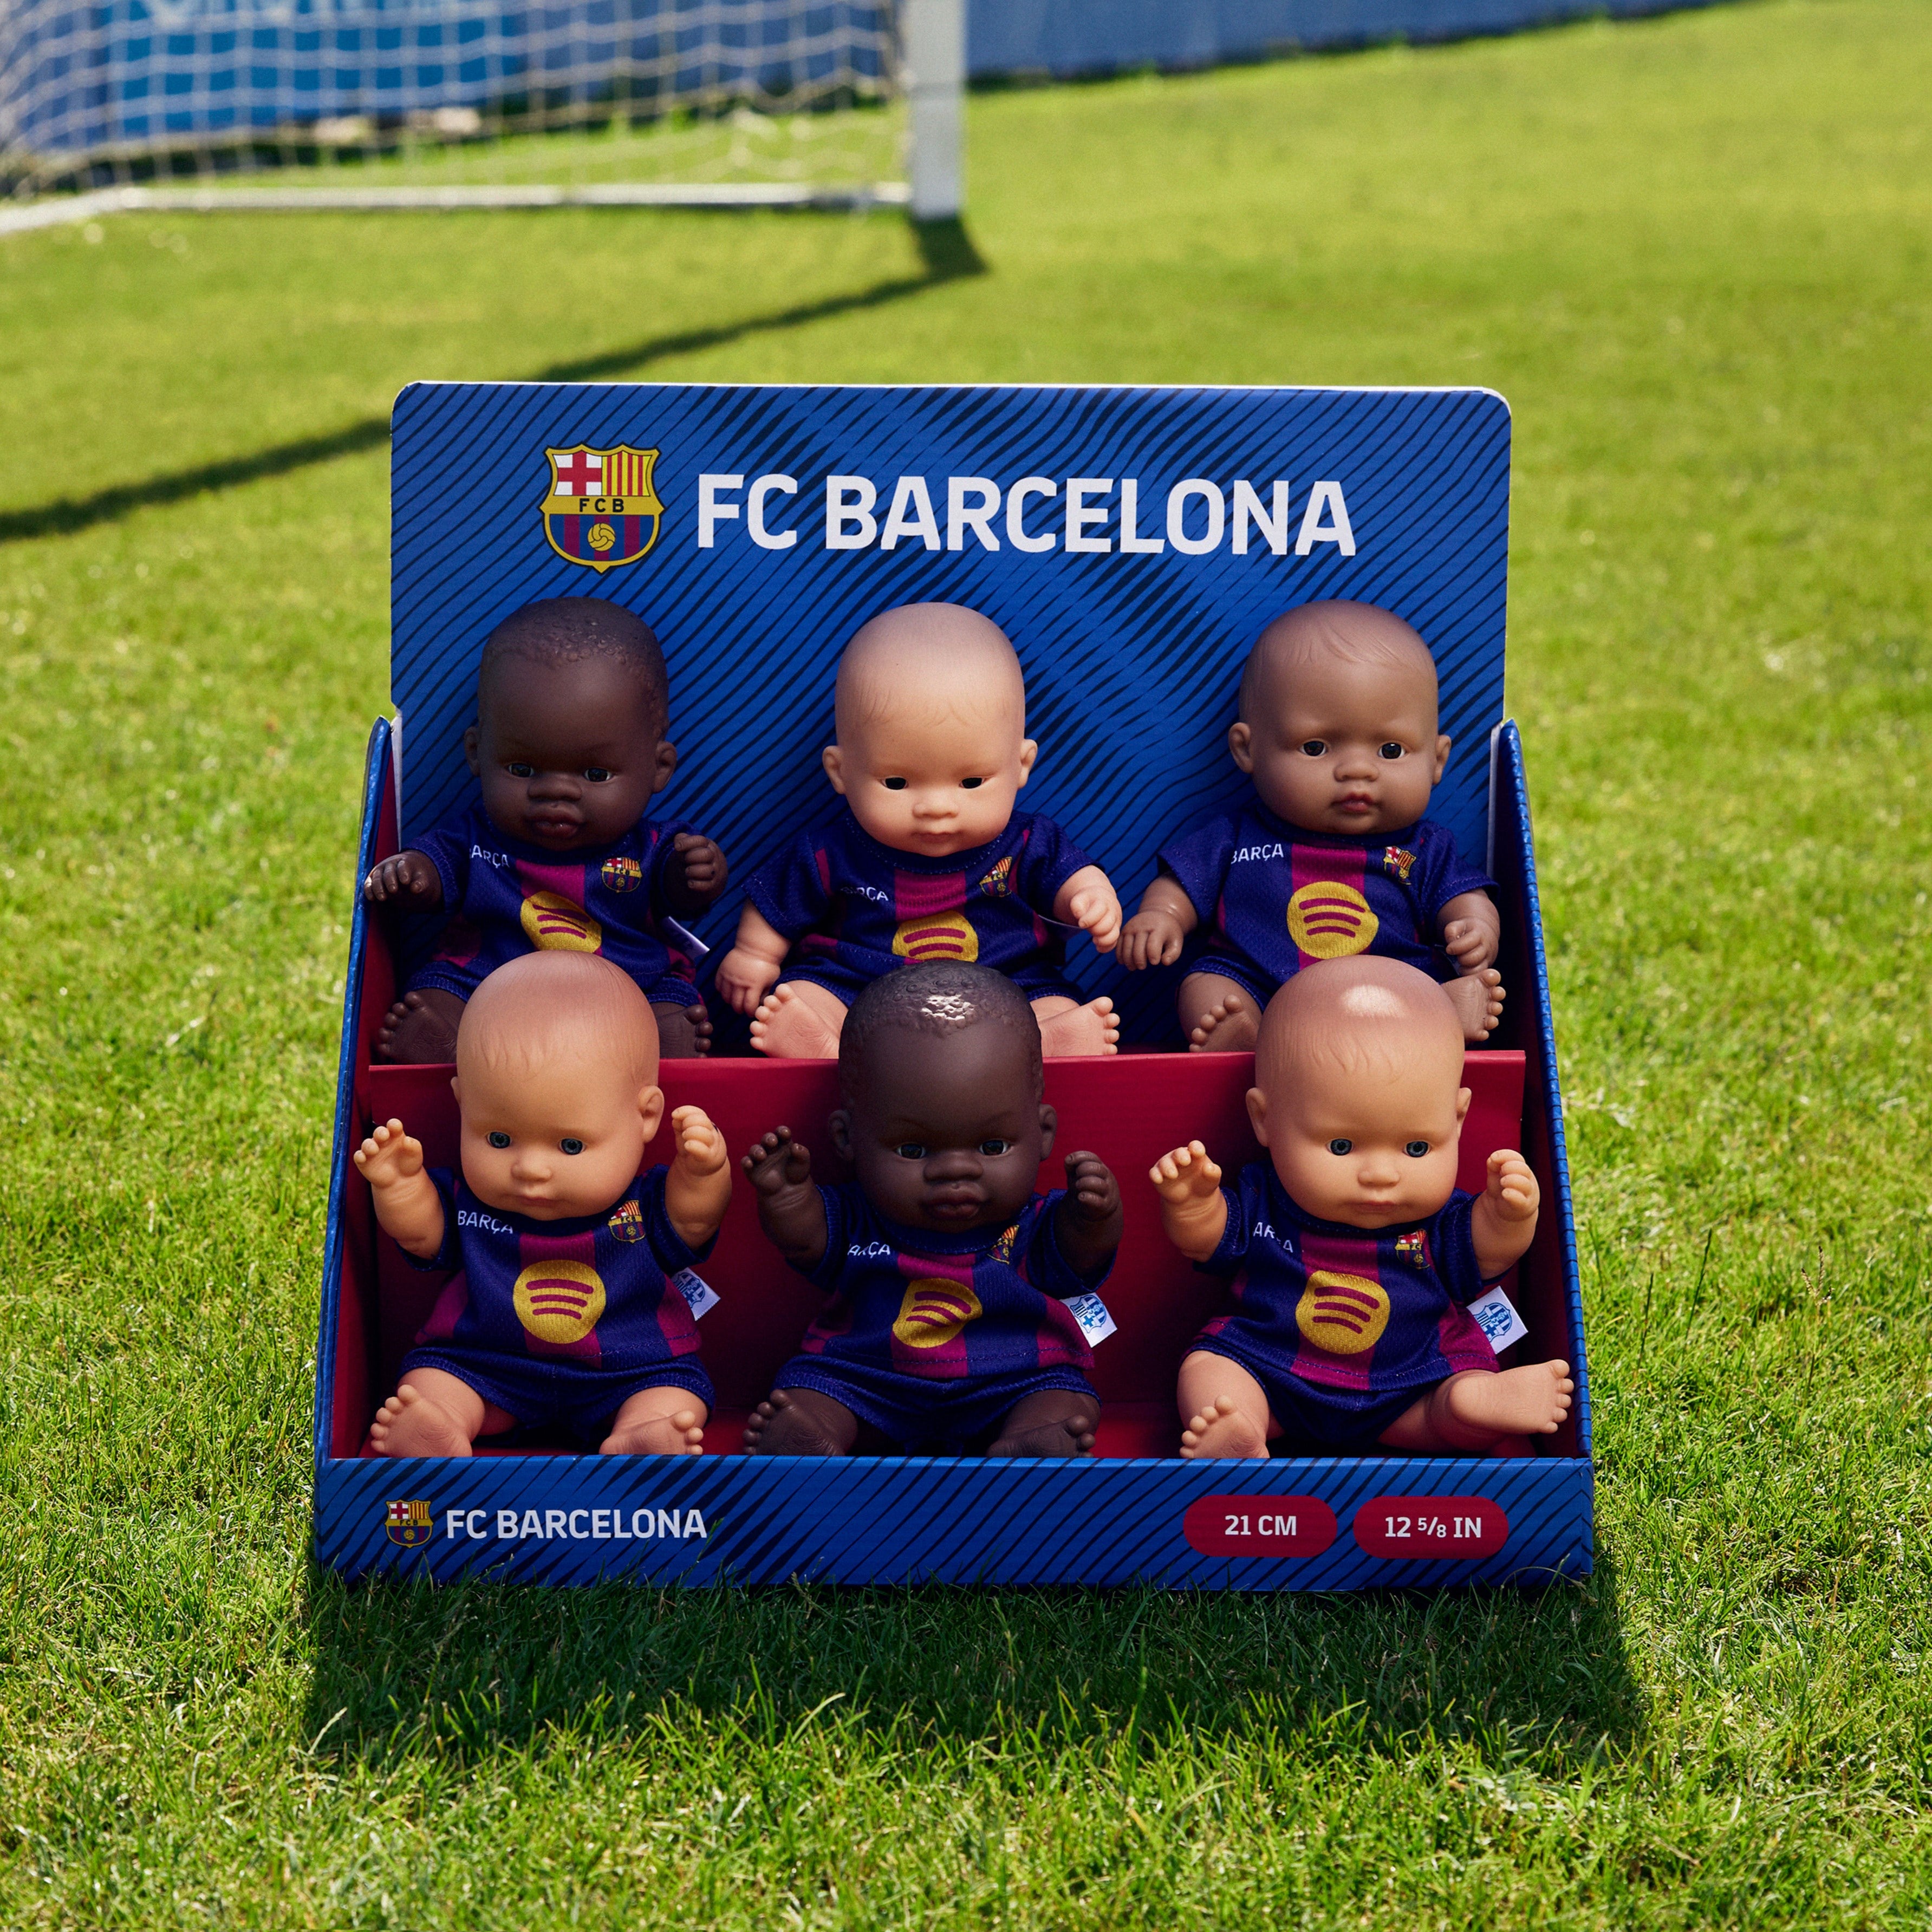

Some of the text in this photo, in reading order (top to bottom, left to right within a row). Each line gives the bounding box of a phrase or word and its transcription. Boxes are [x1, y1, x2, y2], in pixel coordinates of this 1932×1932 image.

[698, 473, 1356, 556] FC BARCELONA
[469, 844, 510, 868] ARÇA
[458, 1210, 513, 1234] BARÇA
[447, 1508, 707, 1539] FC BARCELONA
[1225, 1515, 1297, 1536] 21 CM
[1385, 1517, 1411, 1537] 12
[1453, 1517, 1481, 1538] IN
